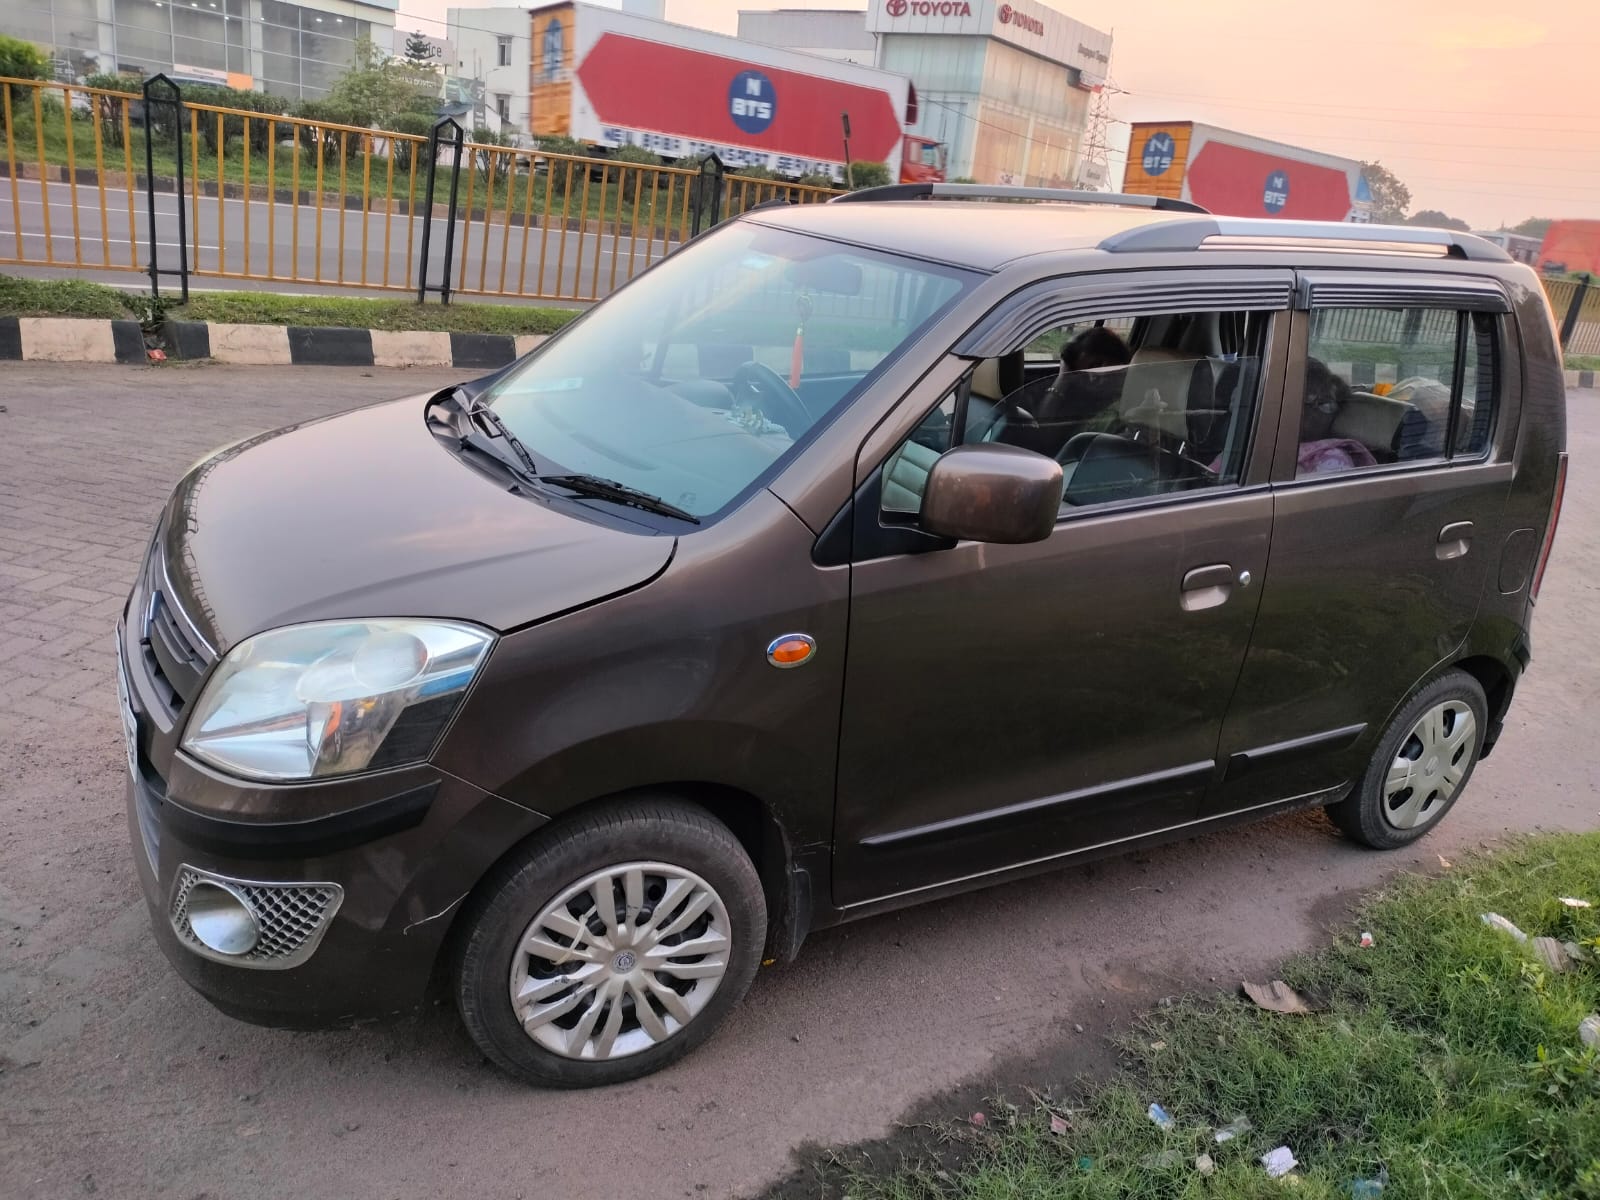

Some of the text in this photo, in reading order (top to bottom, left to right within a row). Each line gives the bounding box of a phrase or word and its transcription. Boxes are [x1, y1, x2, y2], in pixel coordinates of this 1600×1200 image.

[911, 1, 971, 16] TOYOTA
[1012, 10, 1044, 36] TOYOTA
[746, 77, 761, 96] N
[732, 97, 772, 119] BTS
[1149, 138, 1169, 153] N
[1143, 156, 1172, 169] BTS
[1273, 176, 1284, 189] N
[1264, 190, 1287, 206] BTS
